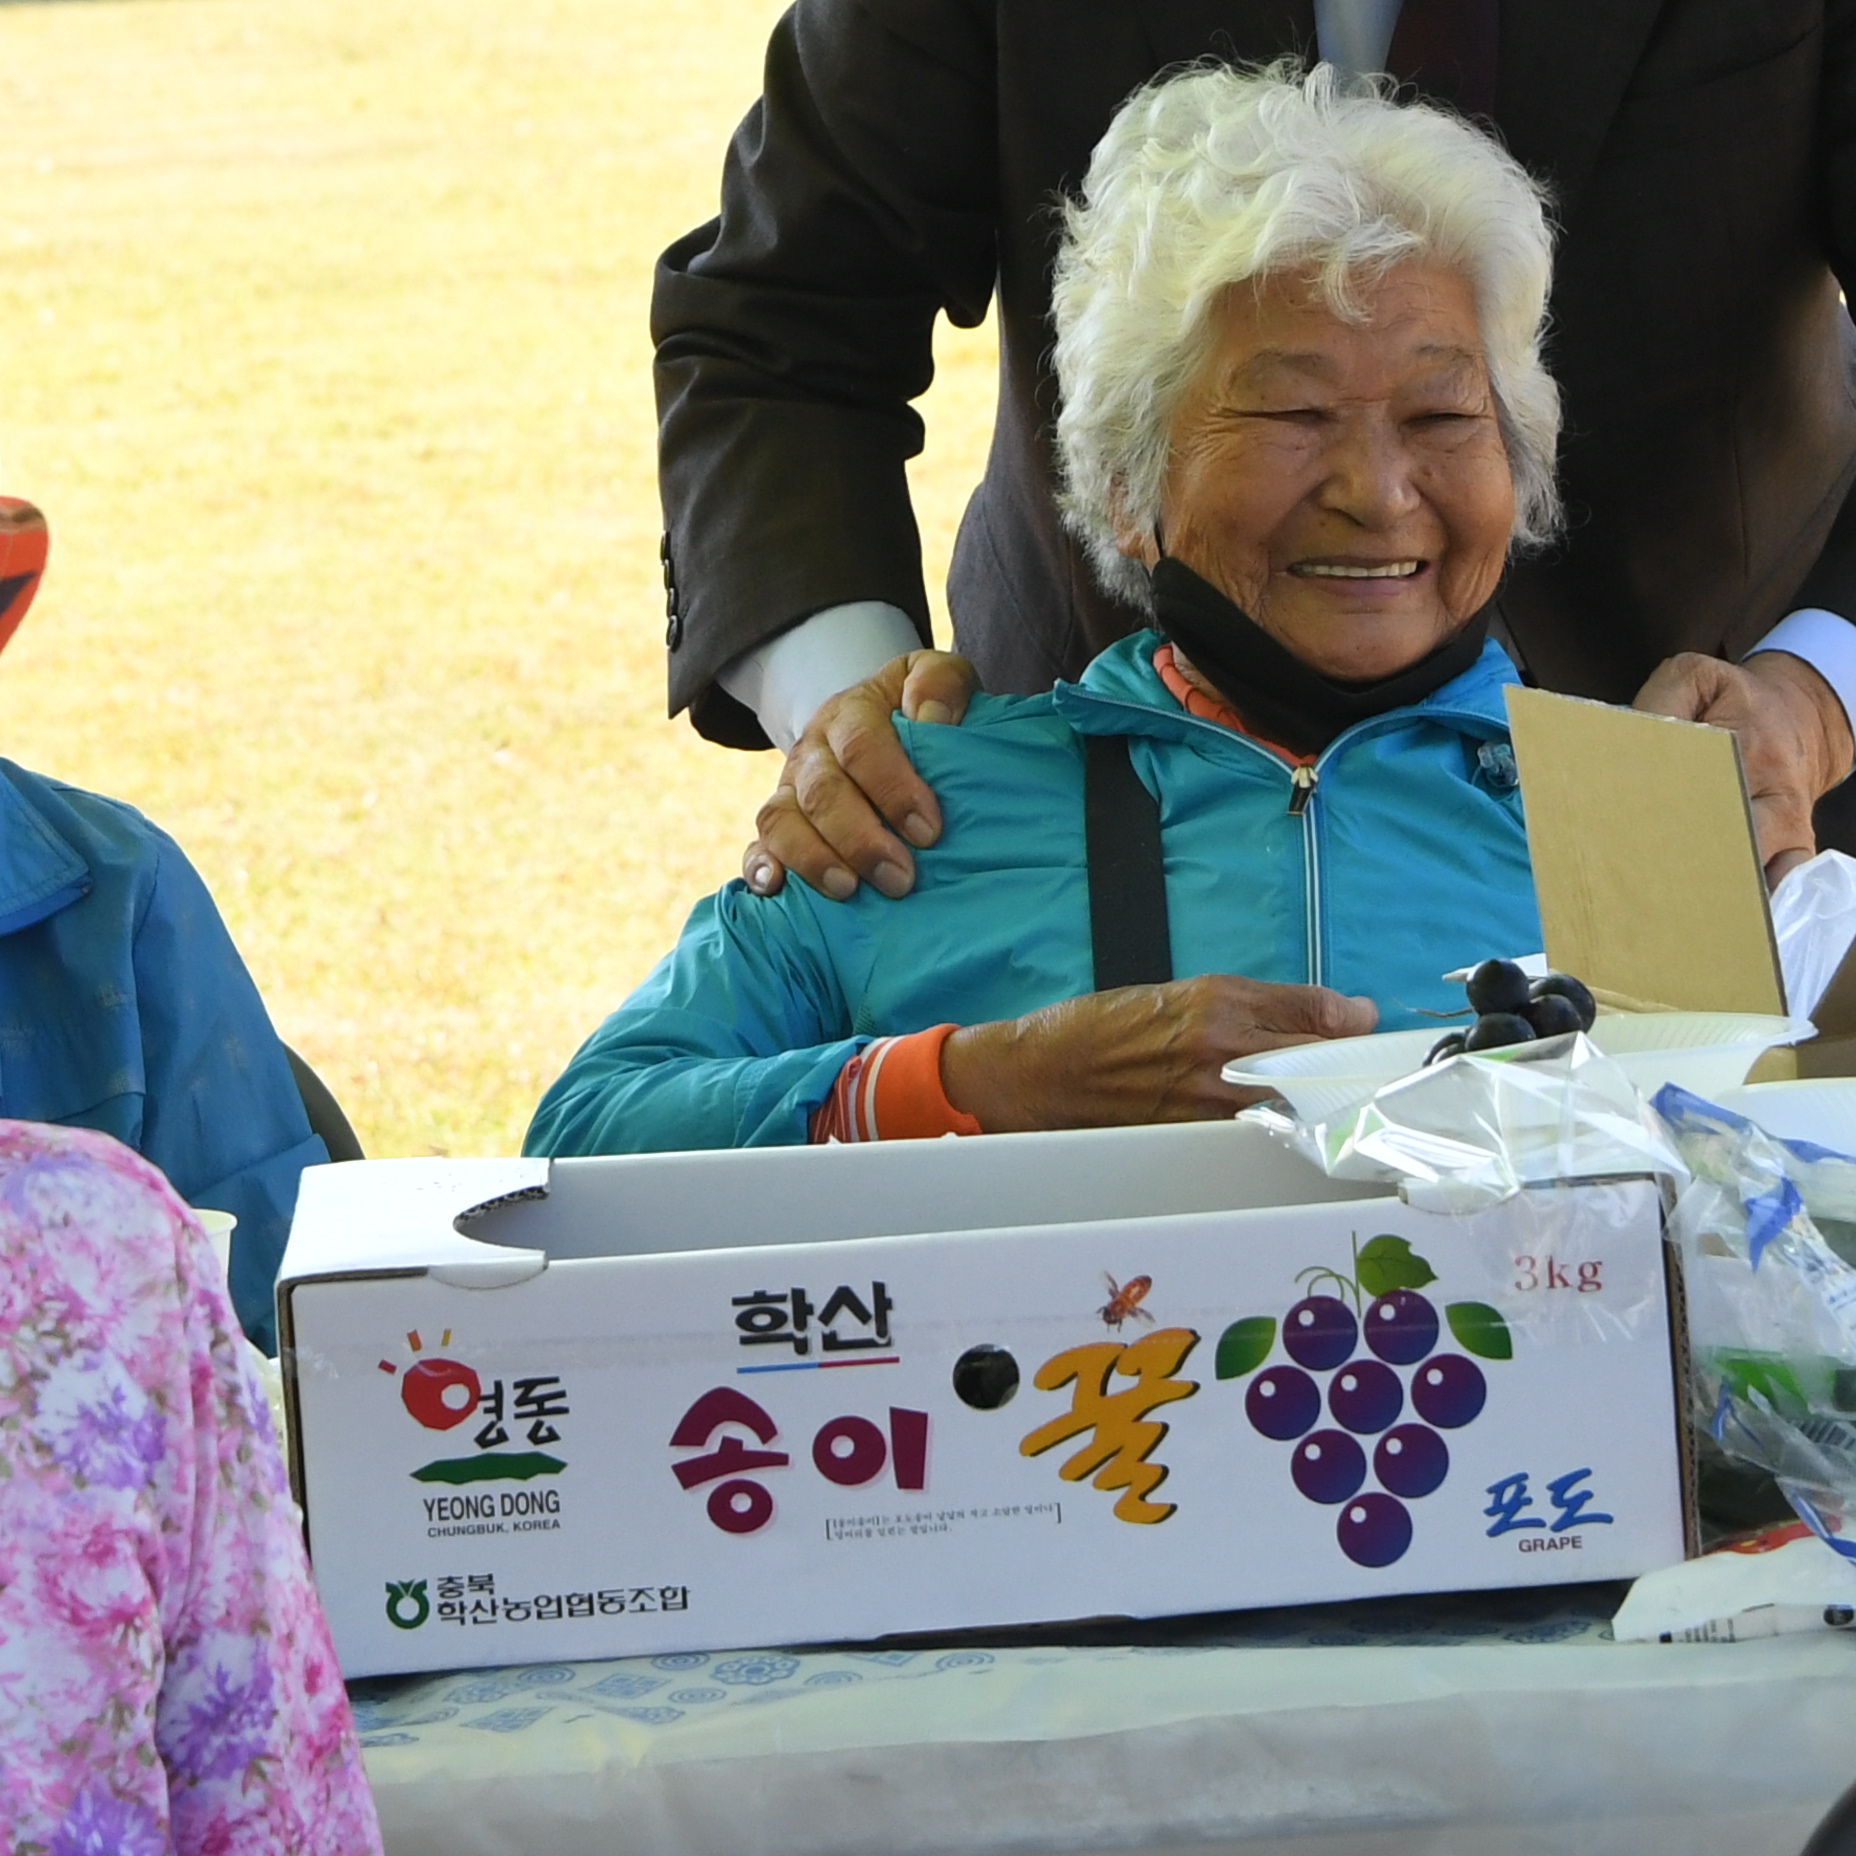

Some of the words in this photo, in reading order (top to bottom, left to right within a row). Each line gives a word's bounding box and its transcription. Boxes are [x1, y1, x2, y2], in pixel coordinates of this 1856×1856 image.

[1512, 1253, 1604, 1295] 3kg
[730, 1280, 894, 1356] 학산
[400, 1357, 570, 1450] 영동
[669, 1386, 930, 1534] 송이
[422, 1494, 495, 1522] YEONG
[500, 1489, 561, 1516] DONG
[1481, 1467, 1615, 1537] 포도
[512, 1518, 561, 1533] KOREA
[1518, 1535, 1584, 1553] GRAPE
[437, 1573, 495, 1599] 충북
[437, 1585, 691, 1626] 학산농업협동조합
